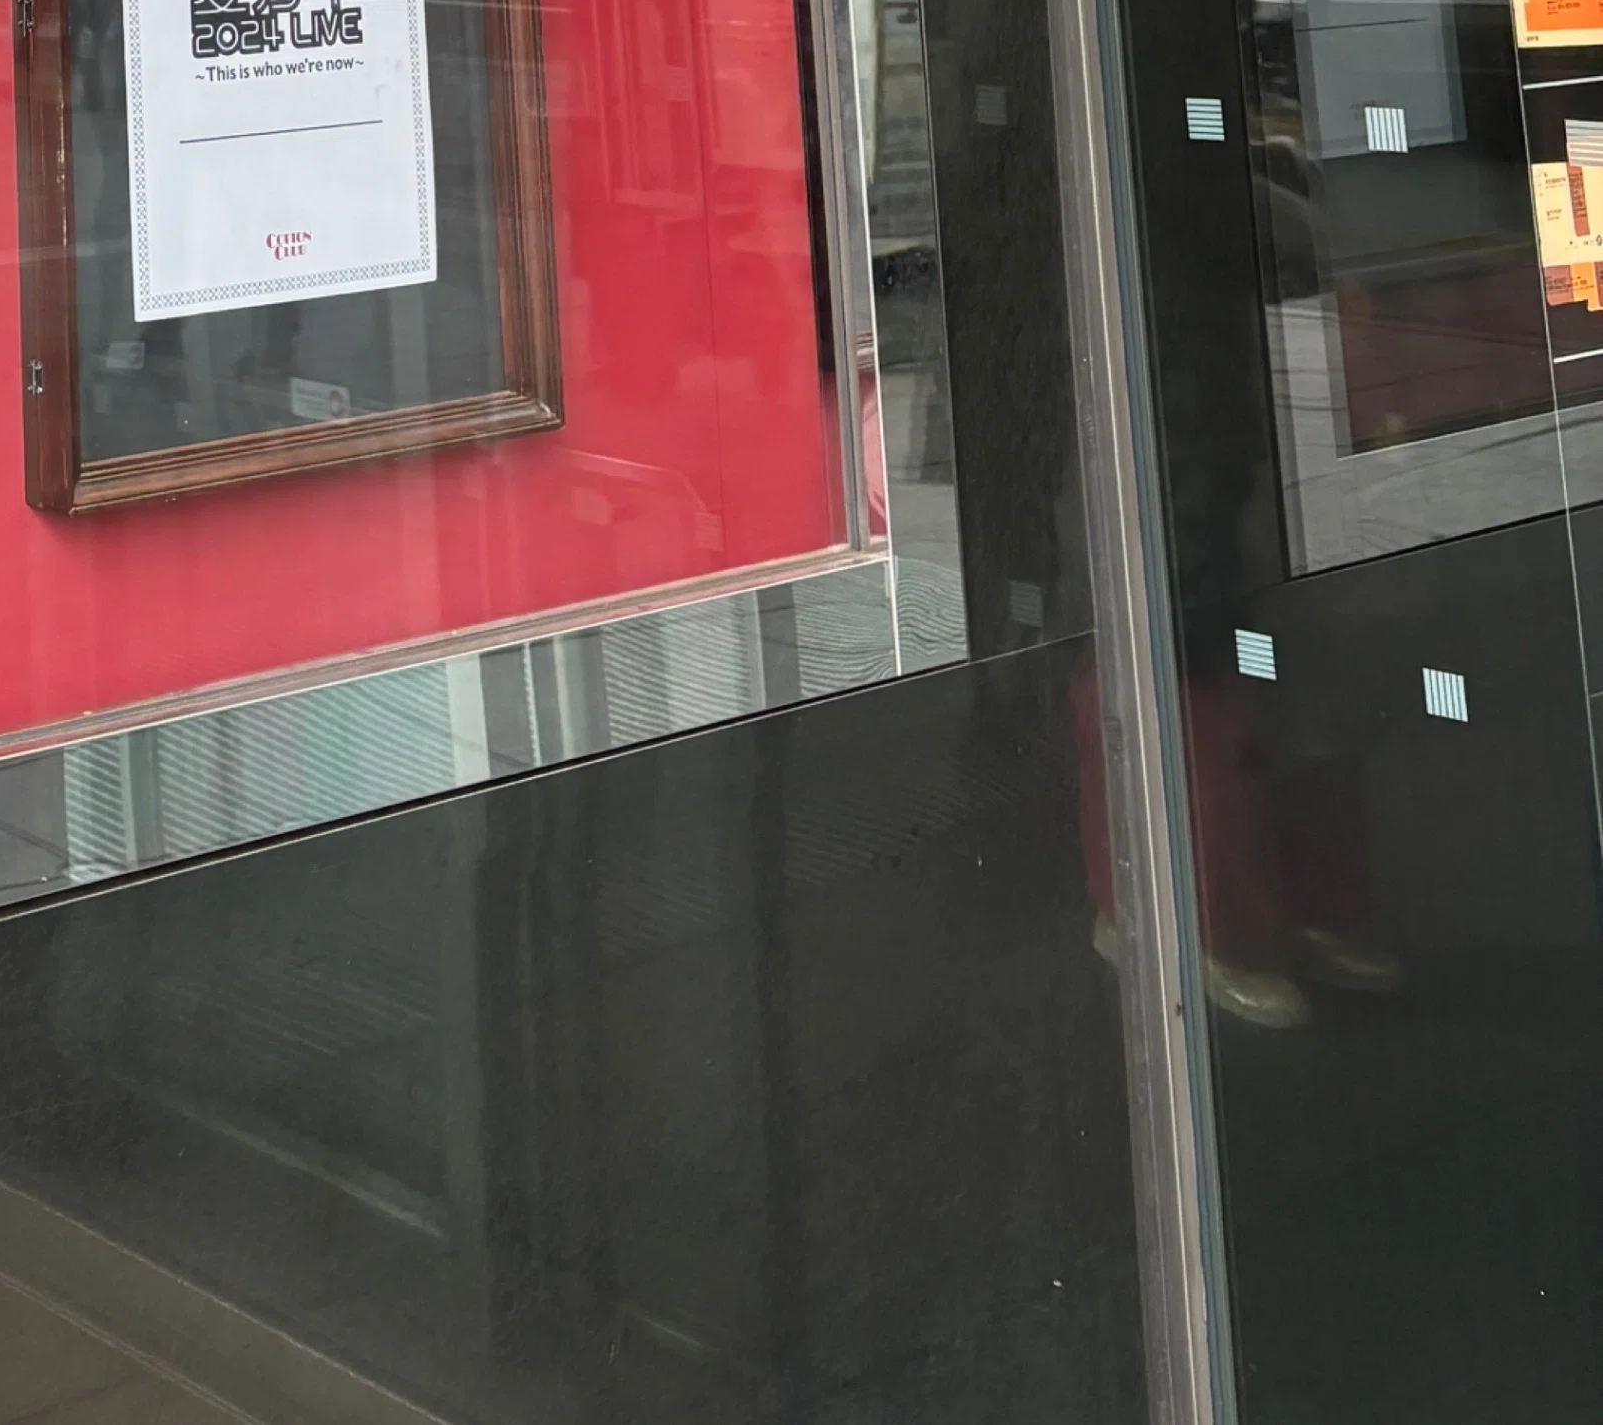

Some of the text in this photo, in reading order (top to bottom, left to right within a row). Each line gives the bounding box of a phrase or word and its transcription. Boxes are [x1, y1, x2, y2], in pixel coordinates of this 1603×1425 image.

[192, 7, 364, 58] 2024 LIVE
[239, 63, 250, 81] is
[253, 61, 283, 78] who
[286, 57, 324, 75] we're
